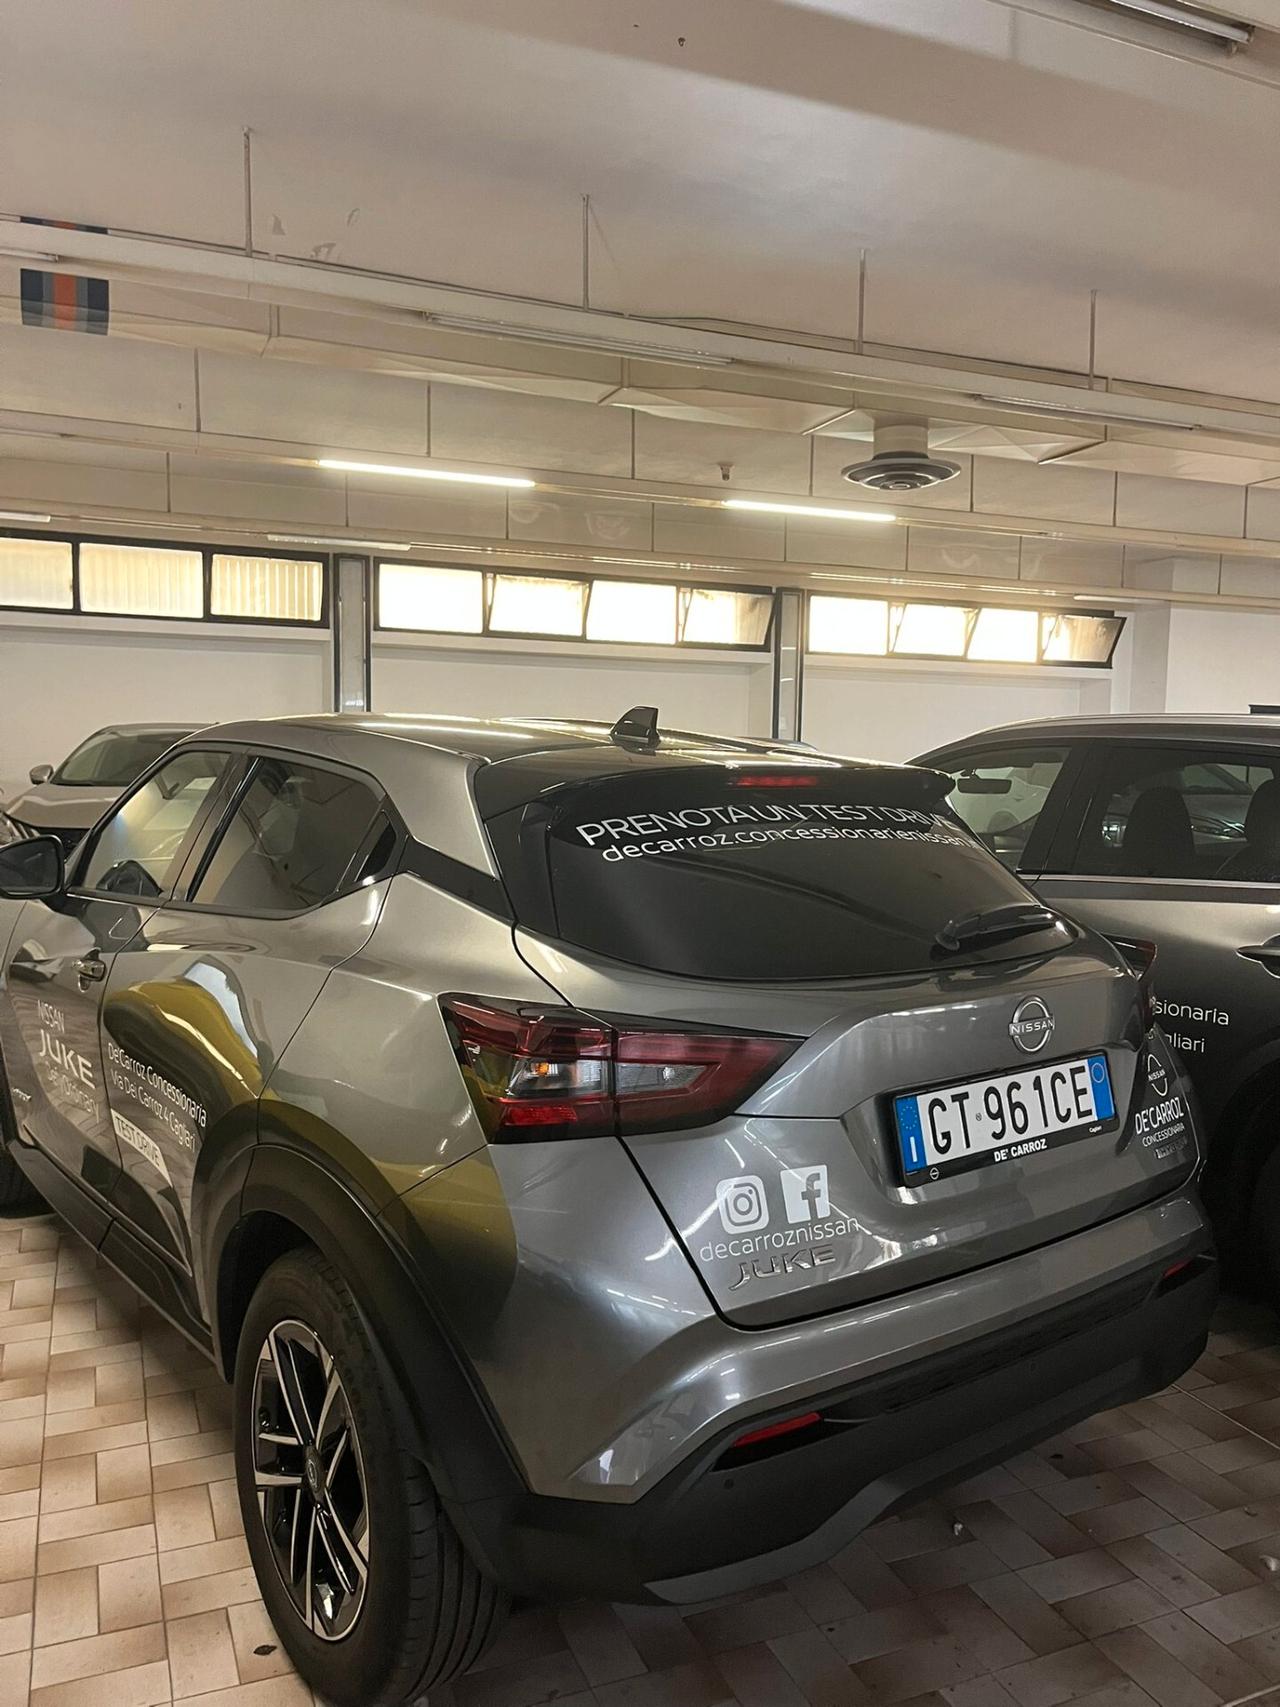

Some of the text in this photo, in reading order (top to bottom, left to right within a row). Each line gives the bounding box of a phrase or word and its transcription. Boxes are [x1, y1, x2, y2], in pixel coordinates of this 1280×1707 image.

[576, 804, 758, 847] PRENOTA
[749, 804, 808, 822] UN
[801, 804, 883, 821] TEST
[38, 1000, 64, 1033] NISSAN
[1010, 1018, 1055, 1035] NISSAN
[39, 1029, 95, 1089] JUKE
[1148, 1069, 1166, 1081] NISSAN
[146, 1065, 207, 1128] Concessionaria
[1010, 1138, 1048, 1157] CARROZ
[699, 1217, 859, 1262] decarroznissan
[728, 1243, 836, 1291] JUKE
